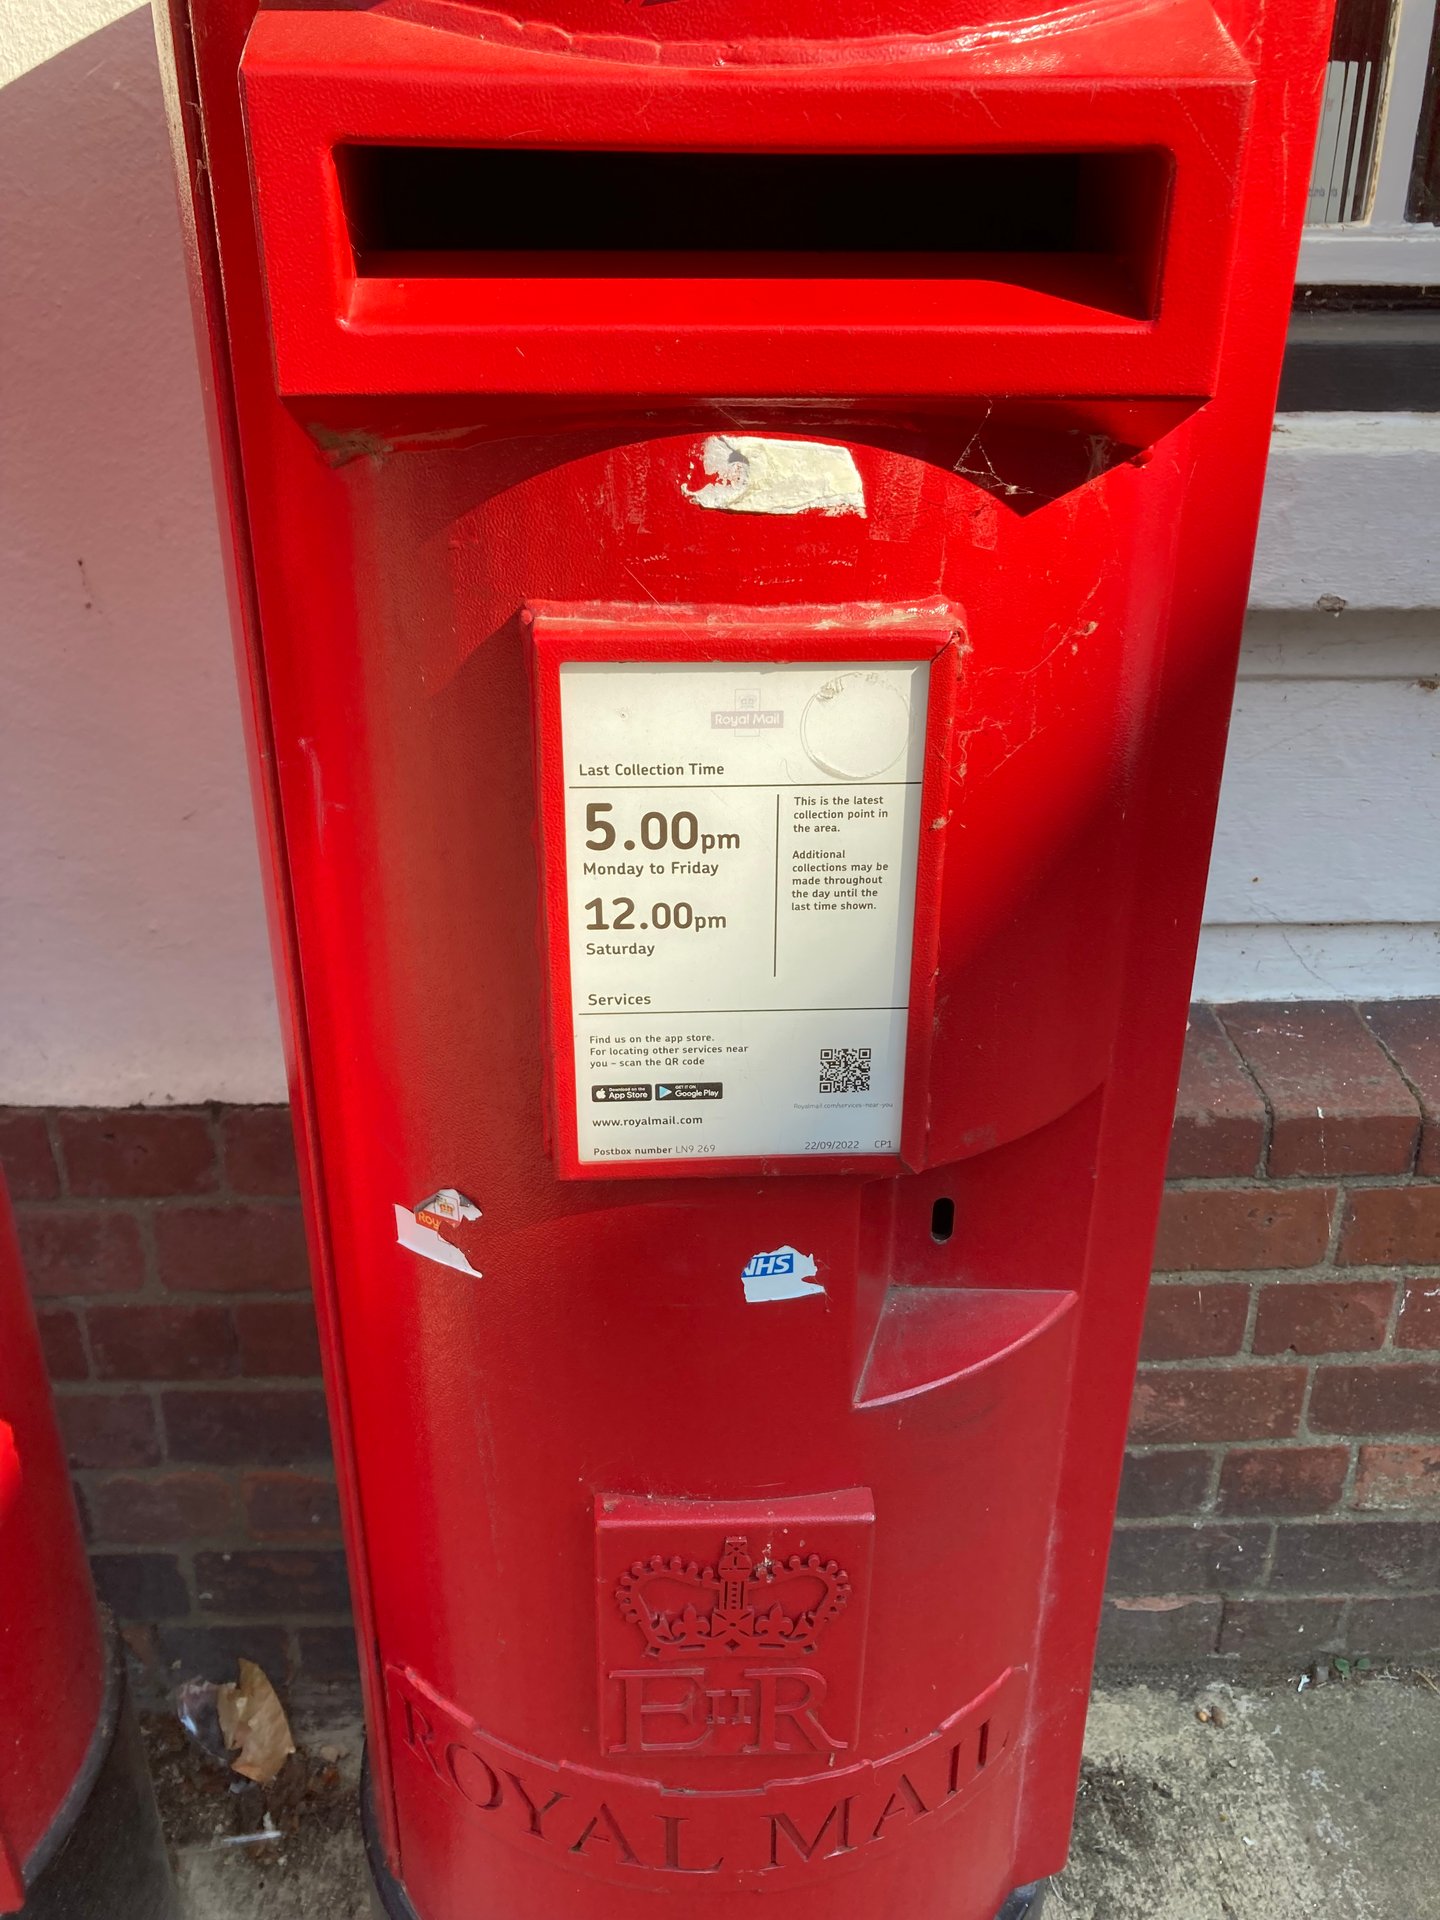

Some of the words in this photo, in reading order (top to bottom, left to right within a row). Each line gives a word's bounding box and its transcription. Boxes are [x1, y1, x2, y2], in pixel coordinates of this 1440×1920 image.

[715, 713, 750, 727] Royal
[752, 713, 779, 725] Mail
[579, 763, 611, 777] Last
[614, 762, 684, 776] Collection
[688, 762, 725, 776] Time
[793, 795, 817, 806] This
[819, 795, 829, 806] is
[832, 795, 850, 806] the
[853, 795, 884, 805] latest
[793, 809, 844, 820] collection
[847, 808, 875, 821] point
[878, 808, 889, 818] in
[585, 802, 741, 855] 5.00pm
[793, 823, 811, 833] the
[813, 825, 841, 833] area.
[792, 849, 846, 860] Additional
[583, 862, 644, 878] Monday
[648, 862, 665, 875] to
[671, 860, 719, 877] Friday
[792, 862, 848, 873] collections
[850, 864, 873, 874] may
[875, 861, 889, 872] be
[792, 876, 821, 886] made
[823, 875, 883, 887] throughout
[791, 889, 809, 899] the
[811, 889, 831, 900] day
[833, 888, 858, 898] until
[860, 888, 878, 898] the
[791, 902, 811, 911] last
[813, 901, 837, 911] time
[840, 901, 877, 911] shown.
[584, 896, 727, 933] 12.00pm
[586, 942, 656, 958] Saturday
[588, 993, 652, 1006] Services
[589, 1035, 611, 1044] Find
[614, 1036, 626, 1044] us
[629, 1036, 642, 1044] on
[645, 1034, 662, 1043] the
[664, 1035, 683, 1044] app
[686, 1034, 714, 1042] store.
[590, 1047, 607, 1056] For
[609, 1046, 649, 1057] locating
[652, 1045, 680, 1055] other
[682, 1044, 723, 1054] services
[590, 1061, 608, 1070] you
[619, 1059, 642, 1067] scan
[644, 1057, 662, 1067] the
[664, 1057, 679, 1066] QR
[682, 1056, 705, 1066] code
[675, 1090, 702, 1098] Google
[704, 1089, 718, 1097] Play
[592, 1115, 703, 1128] www.royalmail.com
[593, 1147, 632, 1156] Postbox
[634, 1146, 673, 1155] number
[675, 1144, 695, 1154] LN9
[697, 1144, 716, 1154] 269
[805, 1141, 859, 1150] 22/09/2022
[874, 1140, 892, 1148] CP1
[744, 1255, 790, 1275] NHS
[402, 1691, 725, 1875] ROYAL
[762, 1717, 1010, 1871] MAIL
